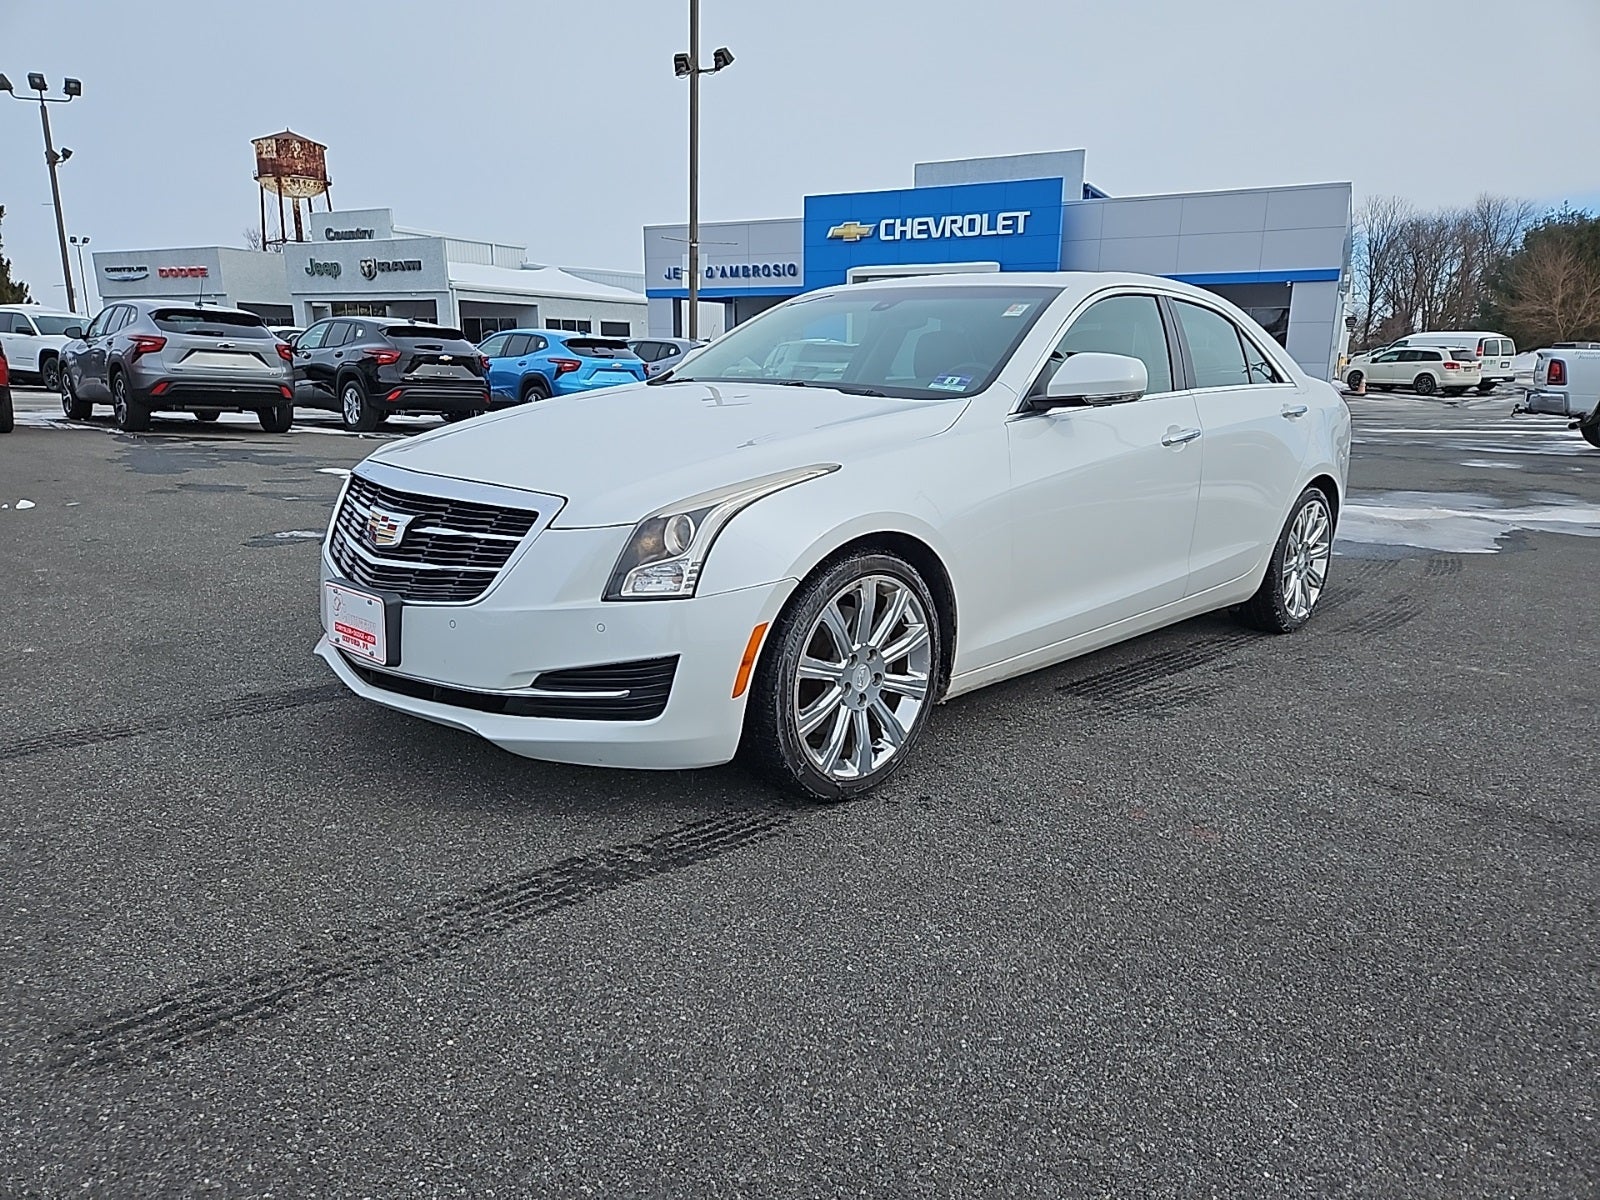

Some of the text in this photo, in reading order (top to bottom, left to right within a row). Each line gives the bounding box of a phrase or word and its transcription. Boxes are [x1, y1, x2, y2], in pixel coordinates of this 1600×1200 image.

[879, 210, 1032, 241] CHEVROLET
[325, 227, 375, 241] Country
[157, 266, 208, 278] DODGE
[305, 258, 342, 280] Jeep
[377, 259, 422, 273] RAM
[705, 263, 799, 280] D'AMBROSIO
